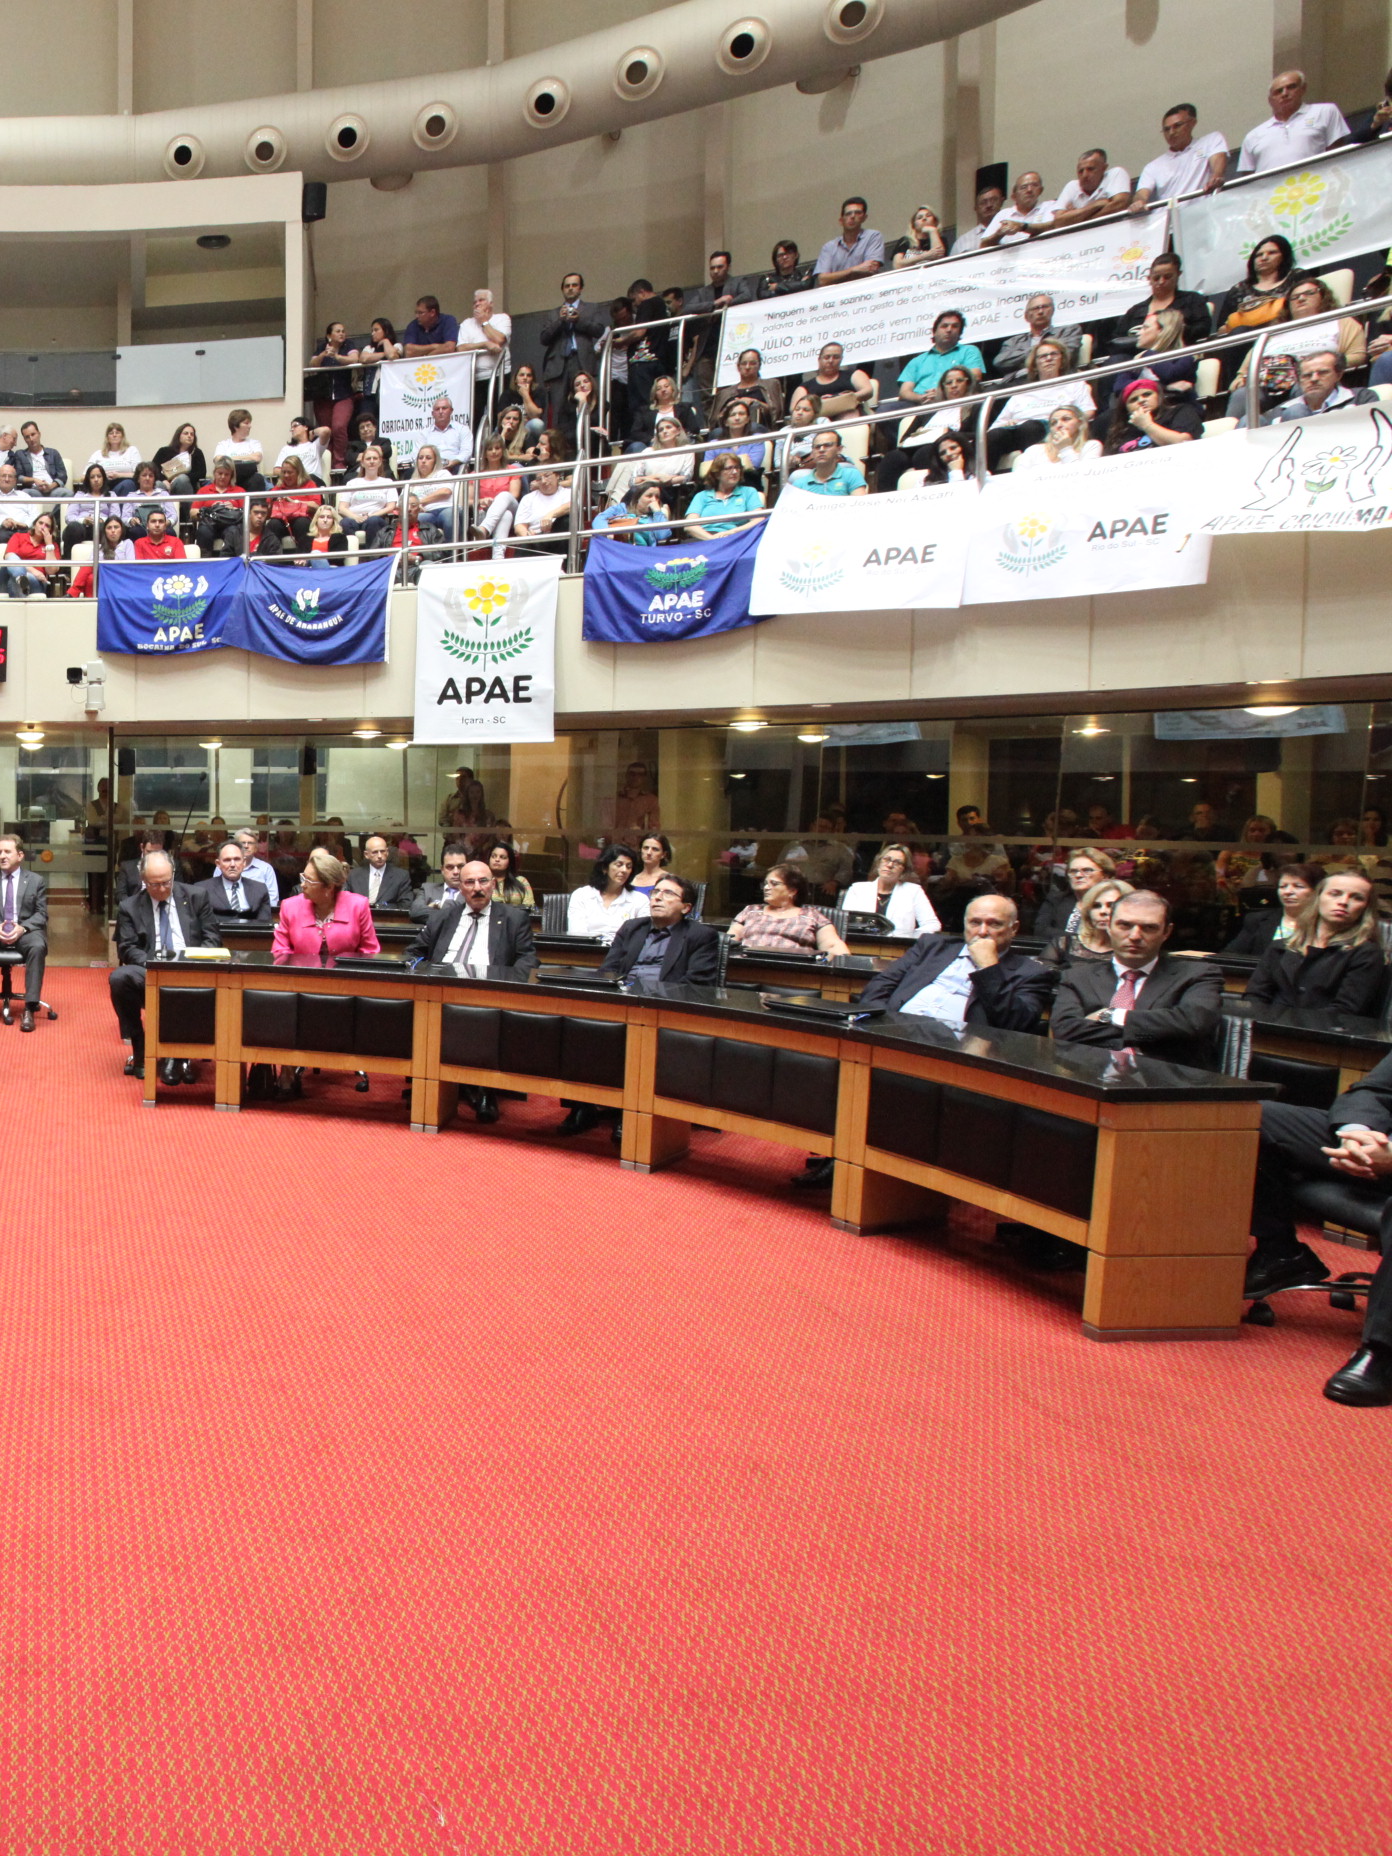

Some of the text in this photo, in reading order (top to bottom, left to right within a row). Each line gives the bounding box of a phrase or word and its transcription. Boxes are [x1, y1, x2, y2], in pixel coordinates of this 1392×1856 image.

[822, 299, 836, 309] faz
[879, 284, 913, 298] sempre
[761, 320, 794, 334] palavra
[796, 317, 808, 326] de
[852, 307, 868, 316] um
[869, 299, 894, 314] gesto
[896, 297, 909, 306] de
[970, 312, 1001, 328] APAE
[1057, 299, 1075, 310] do
[1079, 293, 1099, 306] Sul
[817, 331, 828, 340] 10
[832, 328, 856, 338] anos
[860, 320, 885, 333] você
[889, 318, 911, 327] vem
[915, 313, 934, 322] nos
[381, 418, 414, 434] OBRIGADO
[1087, 513, 1170, 542] APAE
[863, 543, 938, 568] APAE
[1107, 541, 1119, 549] do
[648, 590, 705, 611] APAE
[268, 604, 285, 620] APAE
[284, 614, 296, 625] DE
[640, 612, 683, 624] TURVO
[695, 608, 712, 619] SC
[153, 622, 205, 642] APAE
[436, 674, 533, 706] APAE
[461, 716, 484, 726] Içara
[493, 716, 507, 725] SC
